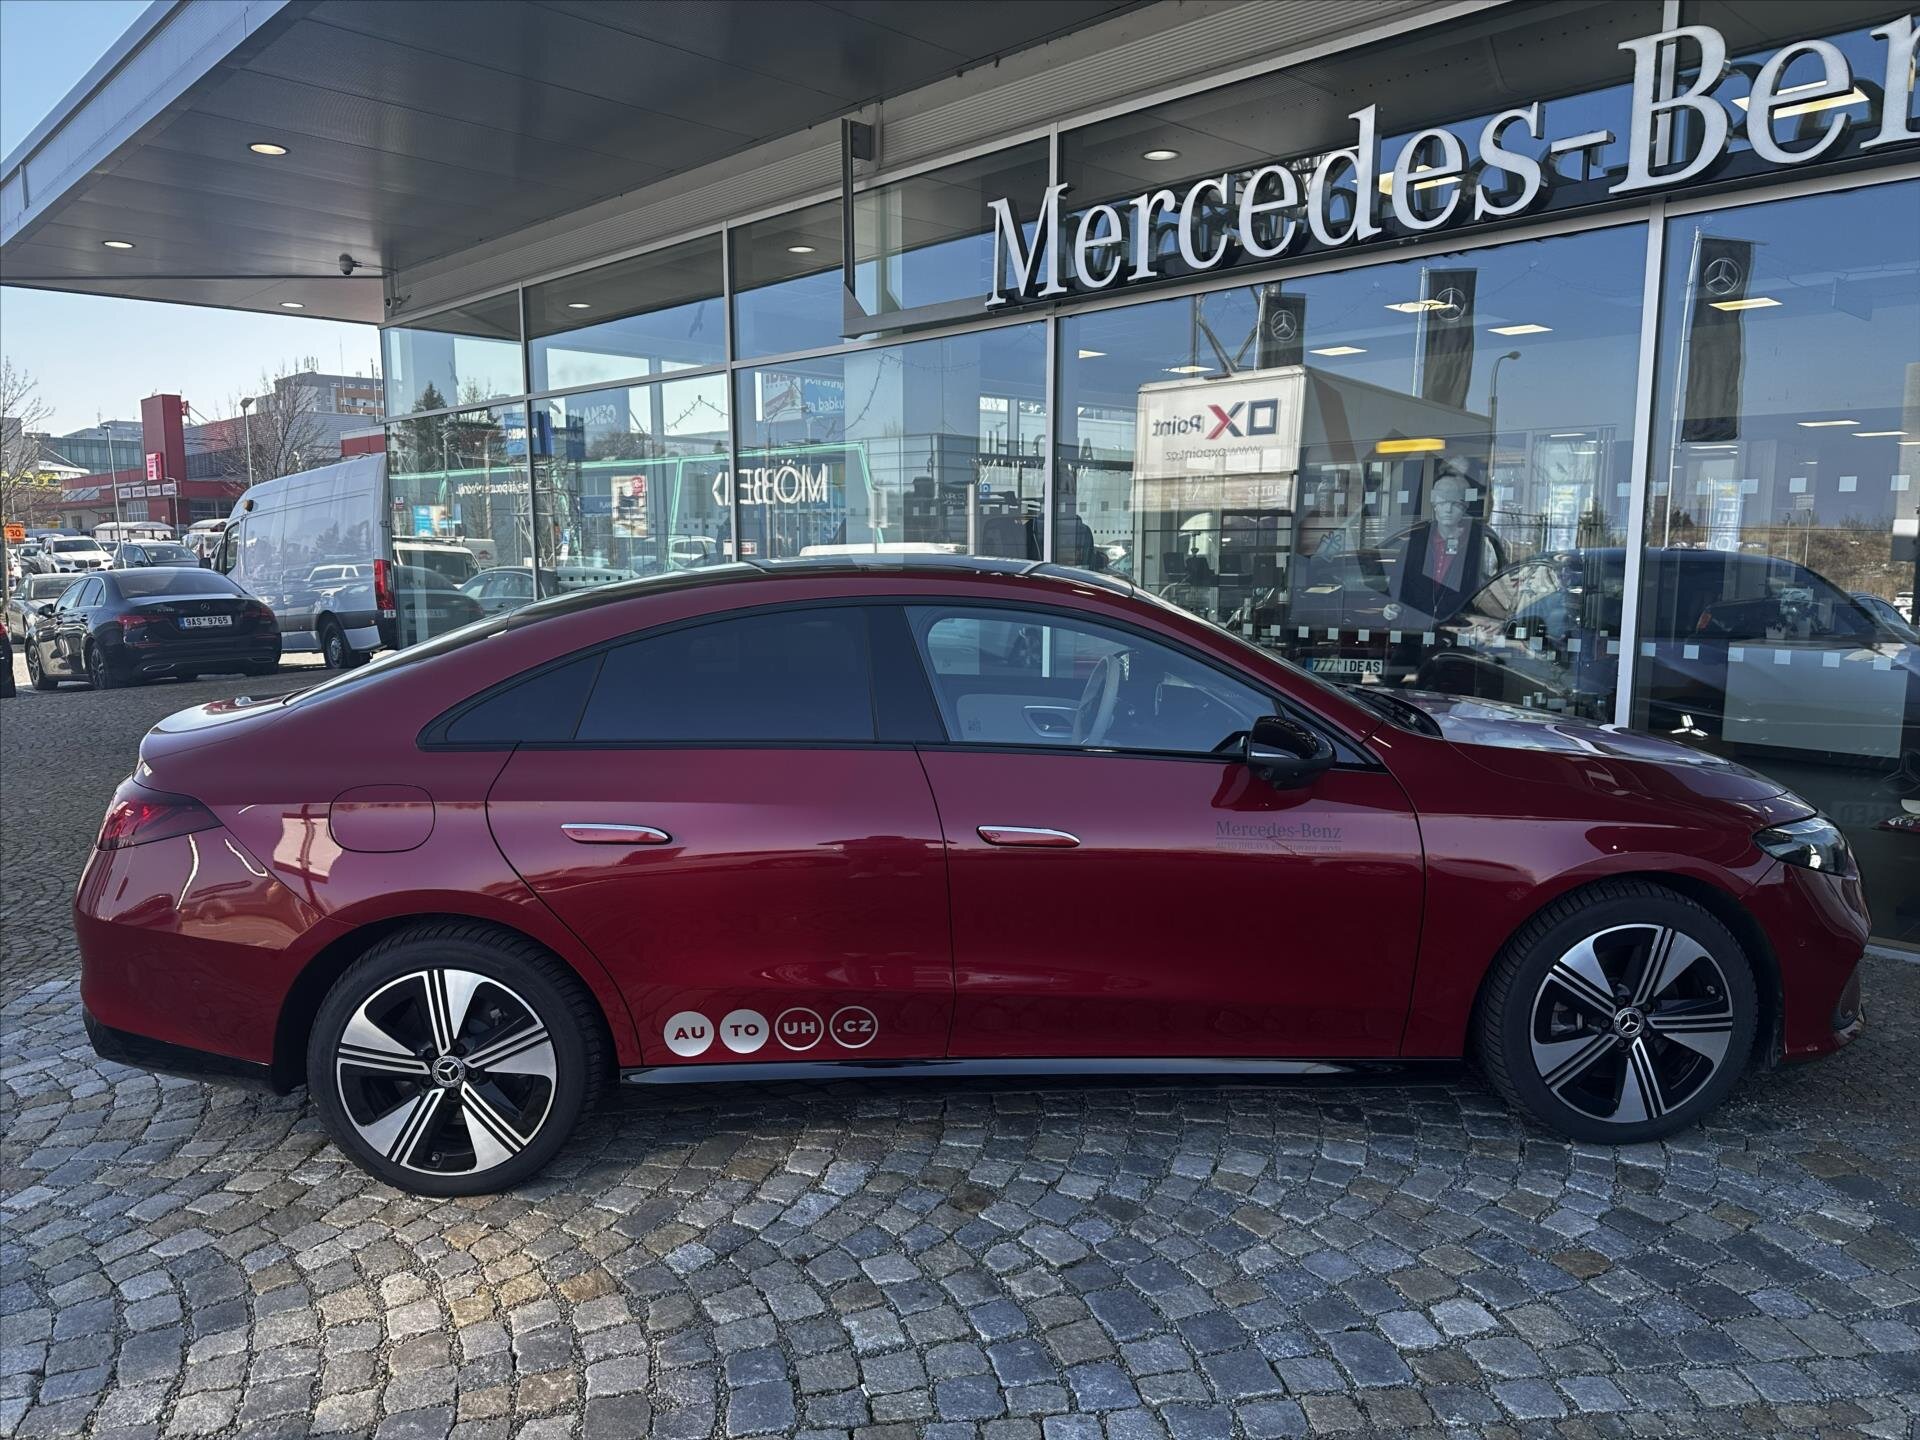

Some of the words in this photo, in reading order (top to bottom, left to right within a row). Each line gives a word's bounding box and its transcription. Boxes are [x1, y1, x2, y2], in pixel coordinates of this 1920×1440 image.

[9, 529, 21, 537] 30
[185, 616, 202, 626] 9AS
[207, 615, 229, 625] 9765
[1313, 659, 1336, 672] 777
[1344, 659, 1381, 674] IDEAS
[1216, 820, 1342, 840] Mercedes-Benz
[673, 1026, 706, 1041] AU
[729, 1023, 760, 1038] TO
[783, 1021, 816, 1035] UH
